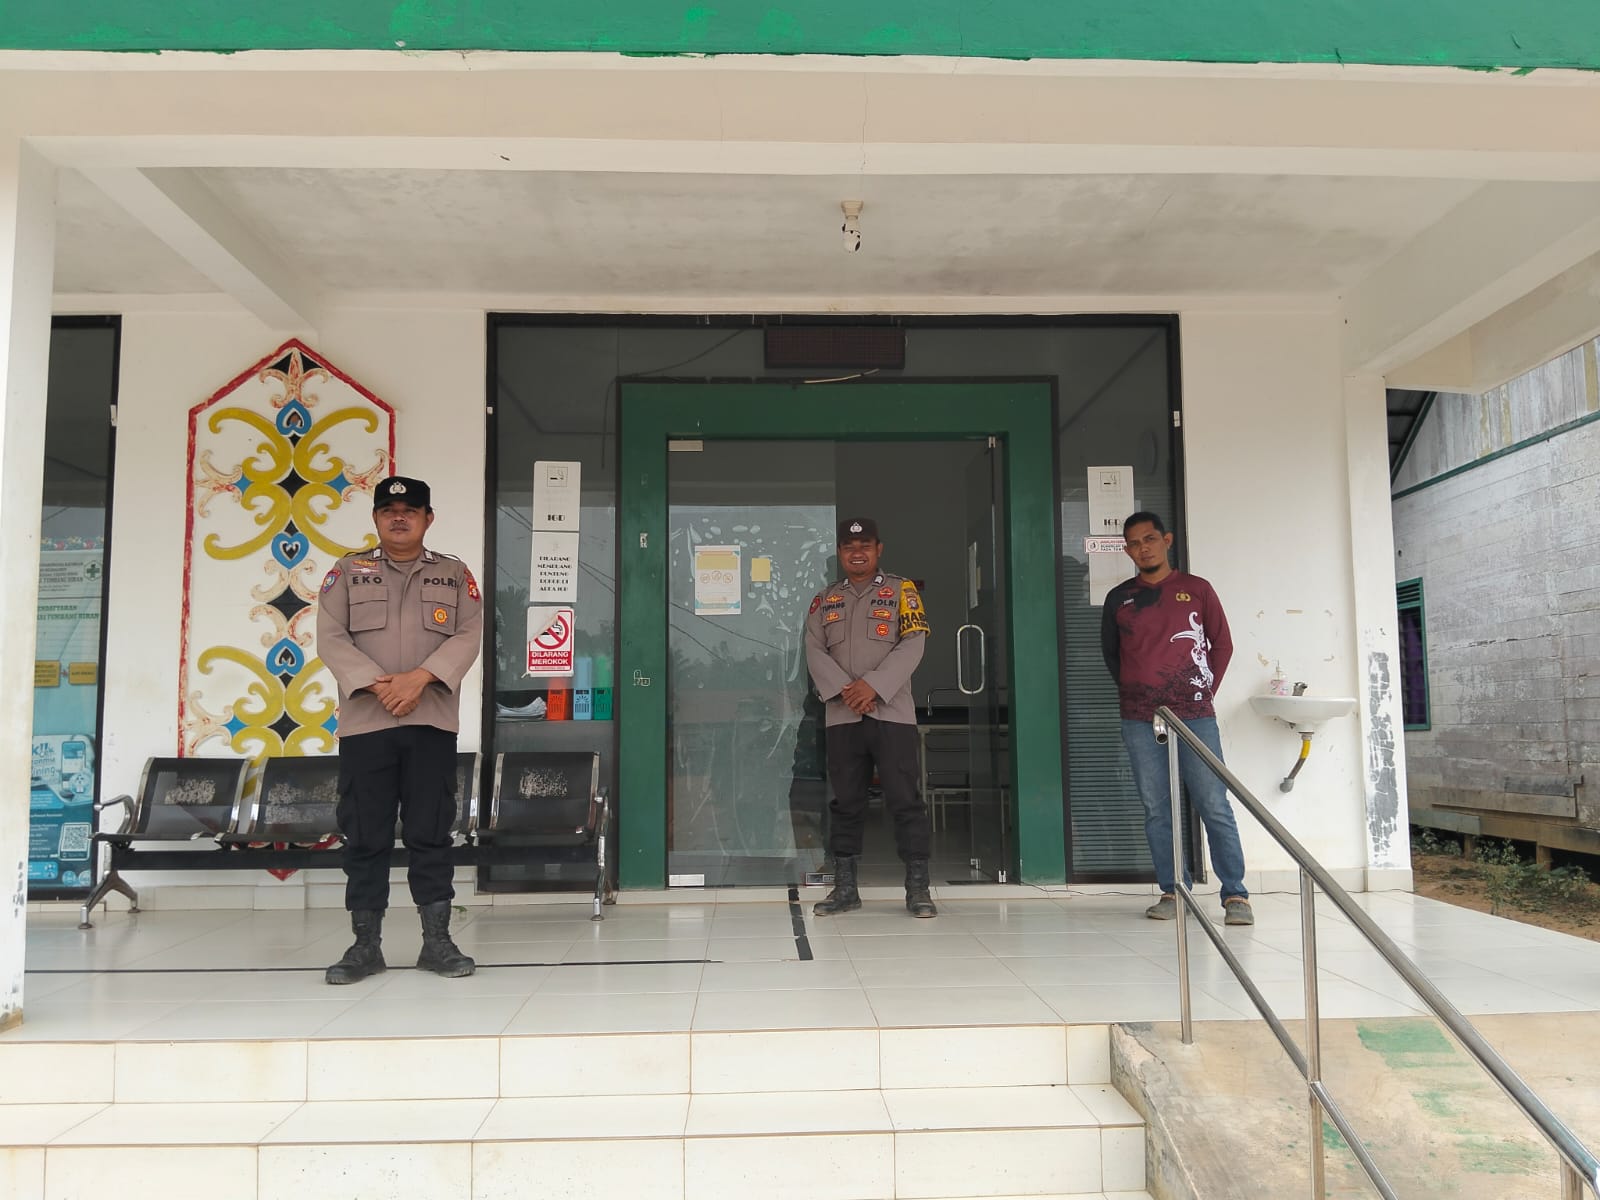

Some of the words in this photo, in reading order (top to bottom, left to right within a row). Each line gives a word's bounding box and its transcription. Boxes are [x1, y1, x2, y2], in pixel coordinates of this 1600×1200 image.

[547, 514, 566, 522] IGD
[352, 575, 383, 586] EKO
[423, 577, 457, 589] POLRI
[870, 599, 898, 609] POLRI
